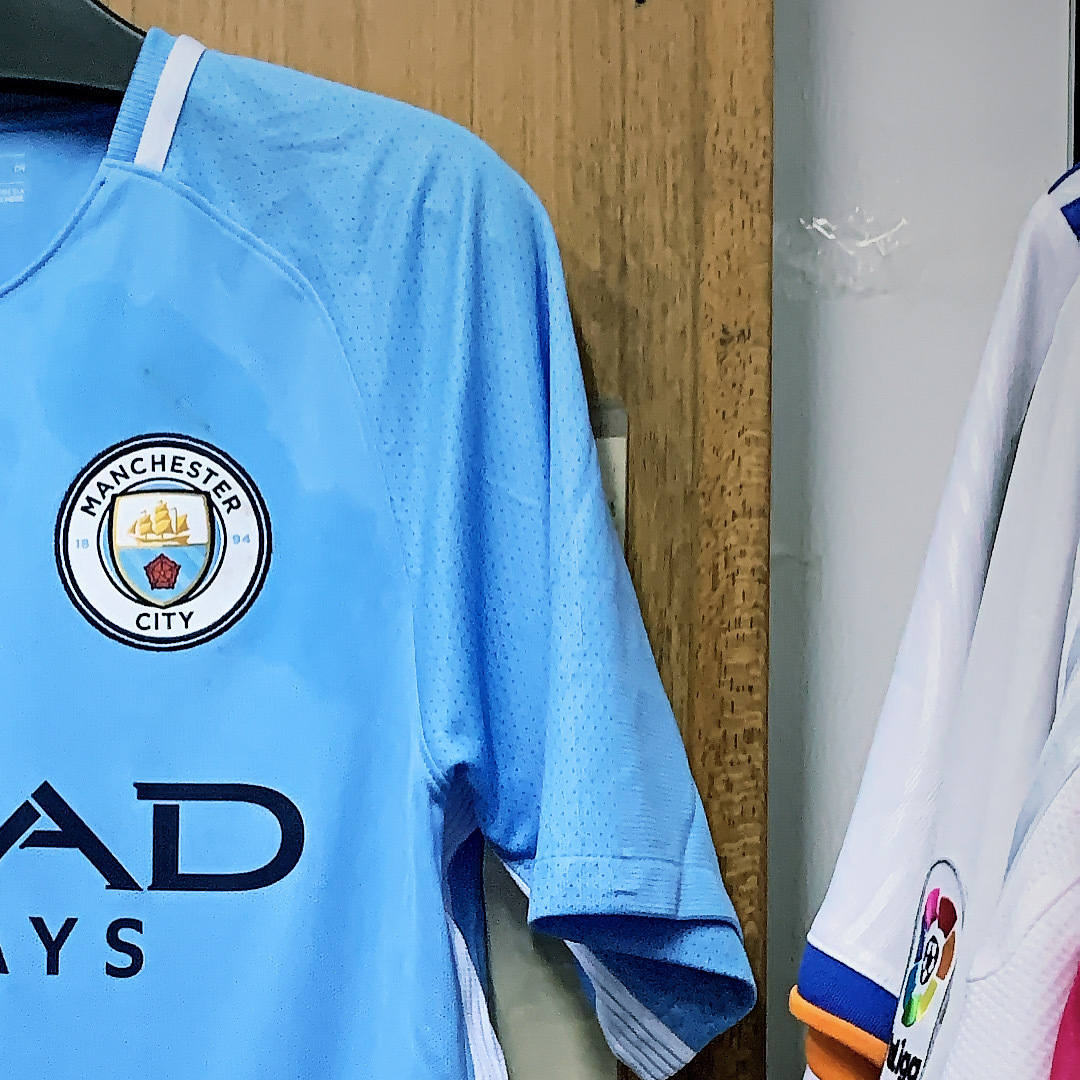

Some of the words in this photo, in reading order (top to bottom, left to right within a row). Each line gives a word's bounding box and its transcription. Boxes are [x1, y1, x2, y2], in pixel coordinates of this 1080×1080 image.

[80, 454, 242, 517] MANCHESTER
[75, 538, 90, 549] 18
[232, 534, 251, 545] 94
[135, 611, 195, 631] CITY
